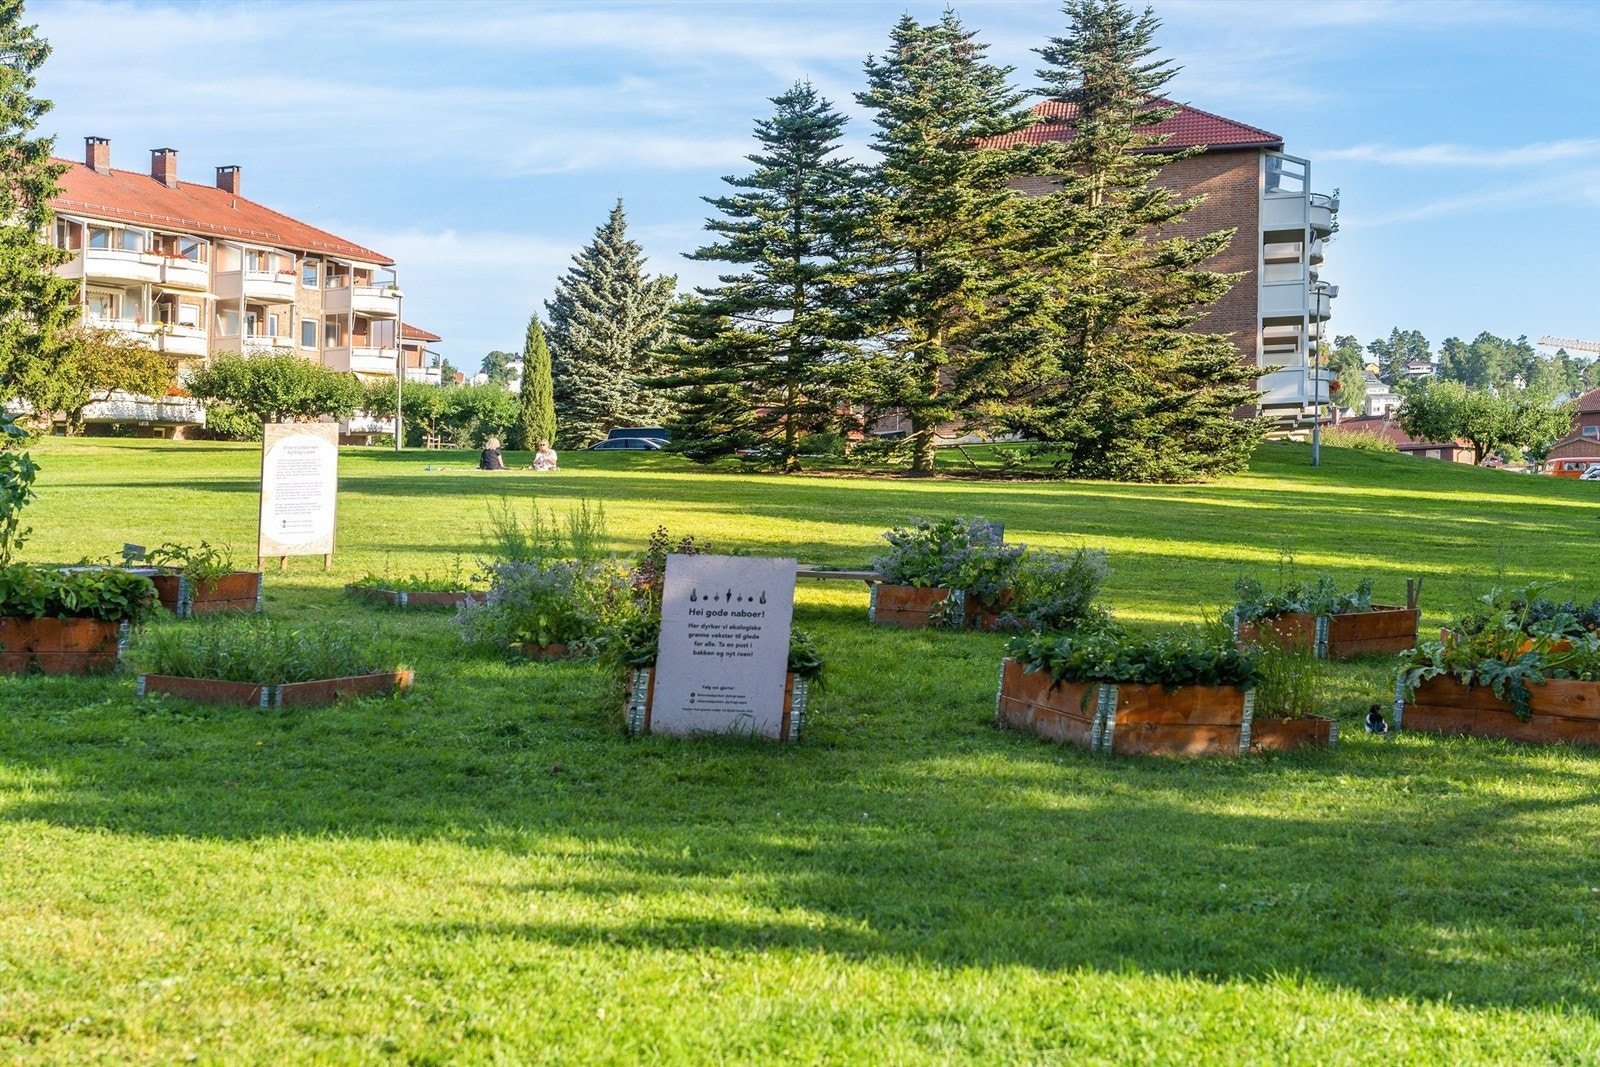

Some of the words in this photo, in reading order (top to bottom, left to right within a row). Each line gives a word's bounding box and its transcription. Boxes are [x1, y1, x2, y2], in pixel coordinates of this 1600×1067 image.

[688, 608, 704, 616] Hei
[706, 609, 728, 618] gode
[730, 610, 765, 618] naboer!
[700, 623, 721, 631] dyrker
